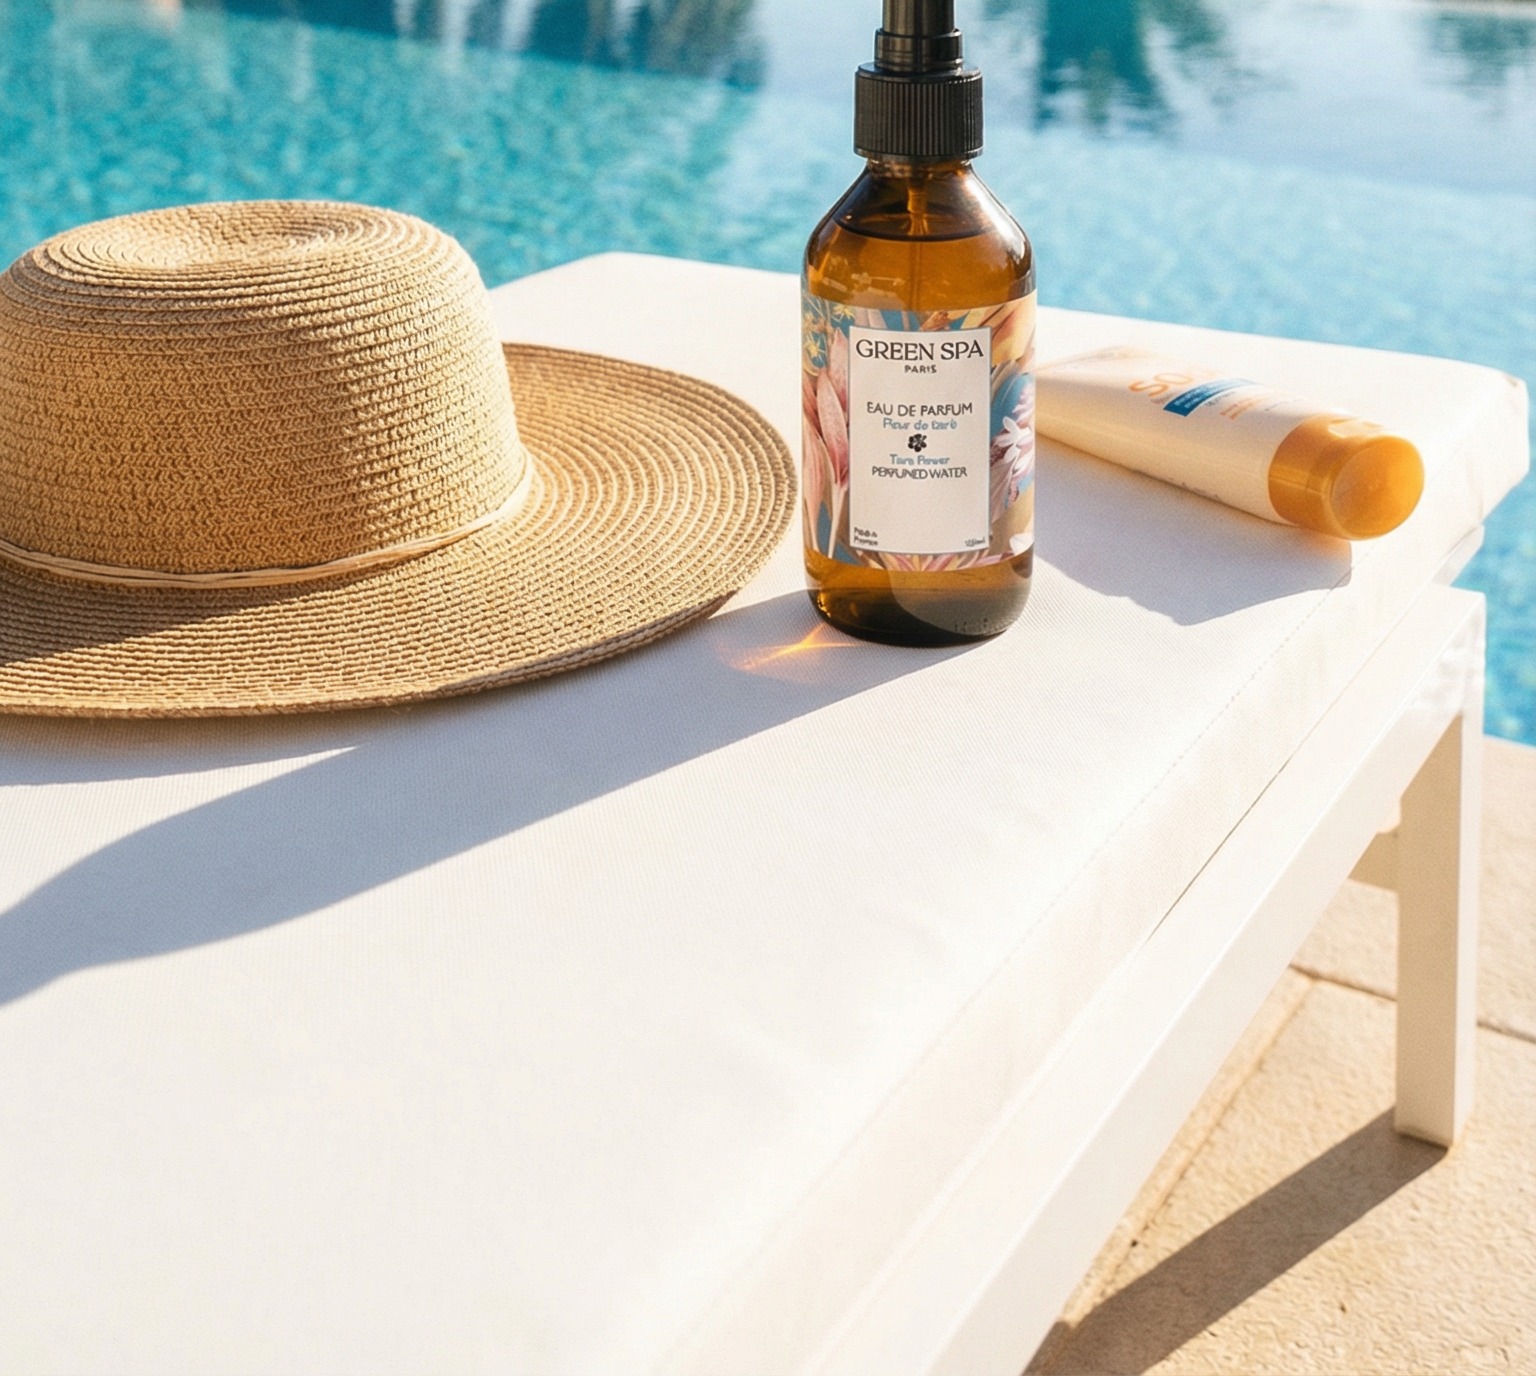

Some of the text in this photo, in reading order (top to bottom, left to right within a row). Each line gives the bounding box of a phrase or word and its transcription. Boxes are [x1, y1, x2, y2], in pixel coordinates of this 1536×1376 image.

[855, 338, 984, 361] GREEN SPA
[904, 364, 937, 374] PARIS
[866, 401, 973, 417] EAU DE PARFUM
[928, 466, 968, 479] WATER
